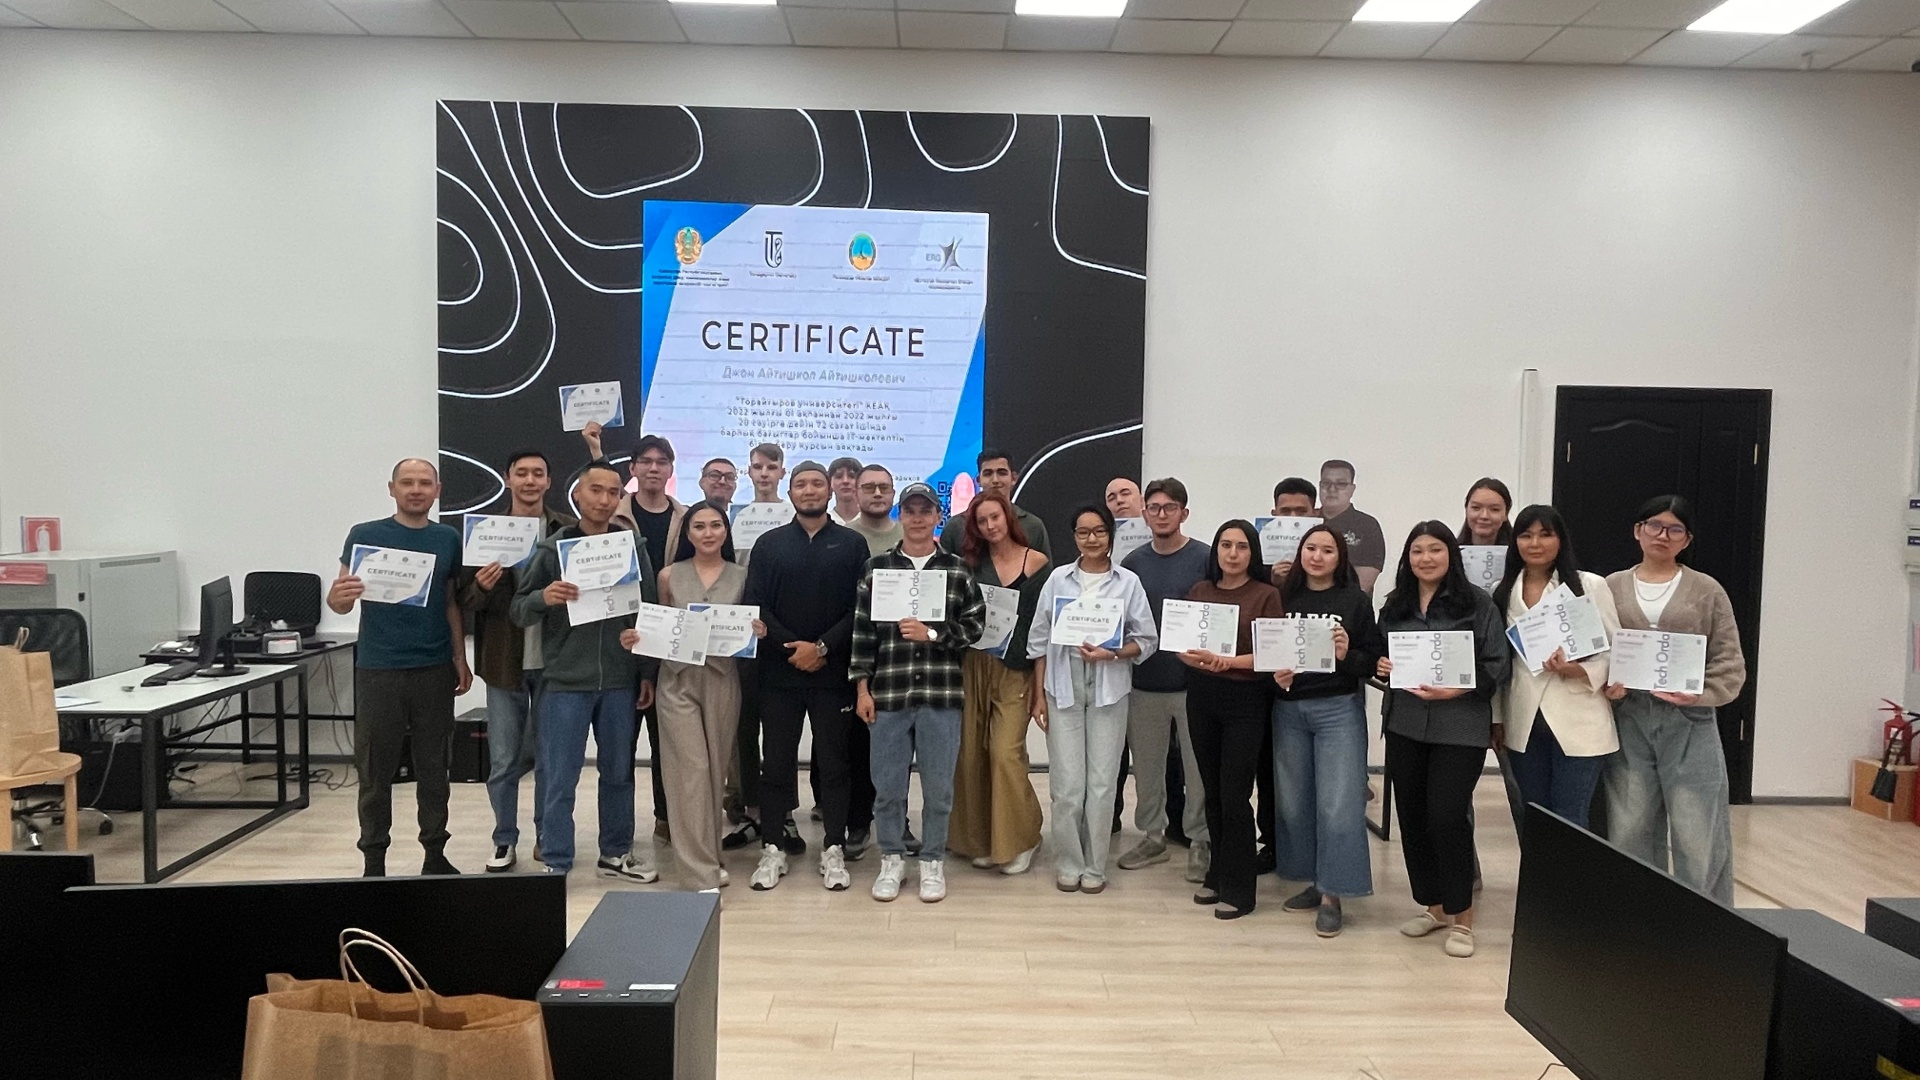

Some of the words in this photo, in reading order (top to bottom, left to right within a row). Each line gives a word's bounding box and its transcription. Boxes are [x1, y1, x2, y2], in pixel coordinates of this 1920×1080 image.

[925, 253, 941, 262] ERG
[701, 320, 925, 357] CERTIFICATE
[722, 366, 755, 379] Джон
[757, 367, 816, 381] Айтишкол
[819, 369, 906, 384] Айтишколович
[727, 406, 749, 416] 2022
[843, 411, 865, 420] 2022
[738, 418, 749, 427] 20
[816, 419, 827, 429] 72
[720, 427, 755, 437] барлық
[478, 534, 524, 542] CERTIFICATE
[575, 552, 622, 565] CERTIFICATE
[367, 567, 417, 579] CERTIFICATE
[908, 570, 920, 597] Orda
[603, 594, 615, 618] Tech
[908, 599, 919, 618] ech
[1198, 603, 1210, 630] Orda
[671, 610, 686, 636] Orda
[710, 624, 745, 632] RTIFICATE
[1066, 616, 1110, 624] CERTIFICATE
[1554, 603, 1571, 634] Orda
[1197, 632, 1208, 650] ech
[1294, 619, 1306, 646] Orda
[667, 638, 680, 659] Tech
[1429, 632, 1443, 661] Orda
[1563, 634, 1578, 660] Tech
[1656, 633, 1671, 663] Orda
[1294, 648, 1306, 669] Tech
[1430, 663, 1443, 686] Tech
[1654, 665, 1668, 689] Tech
